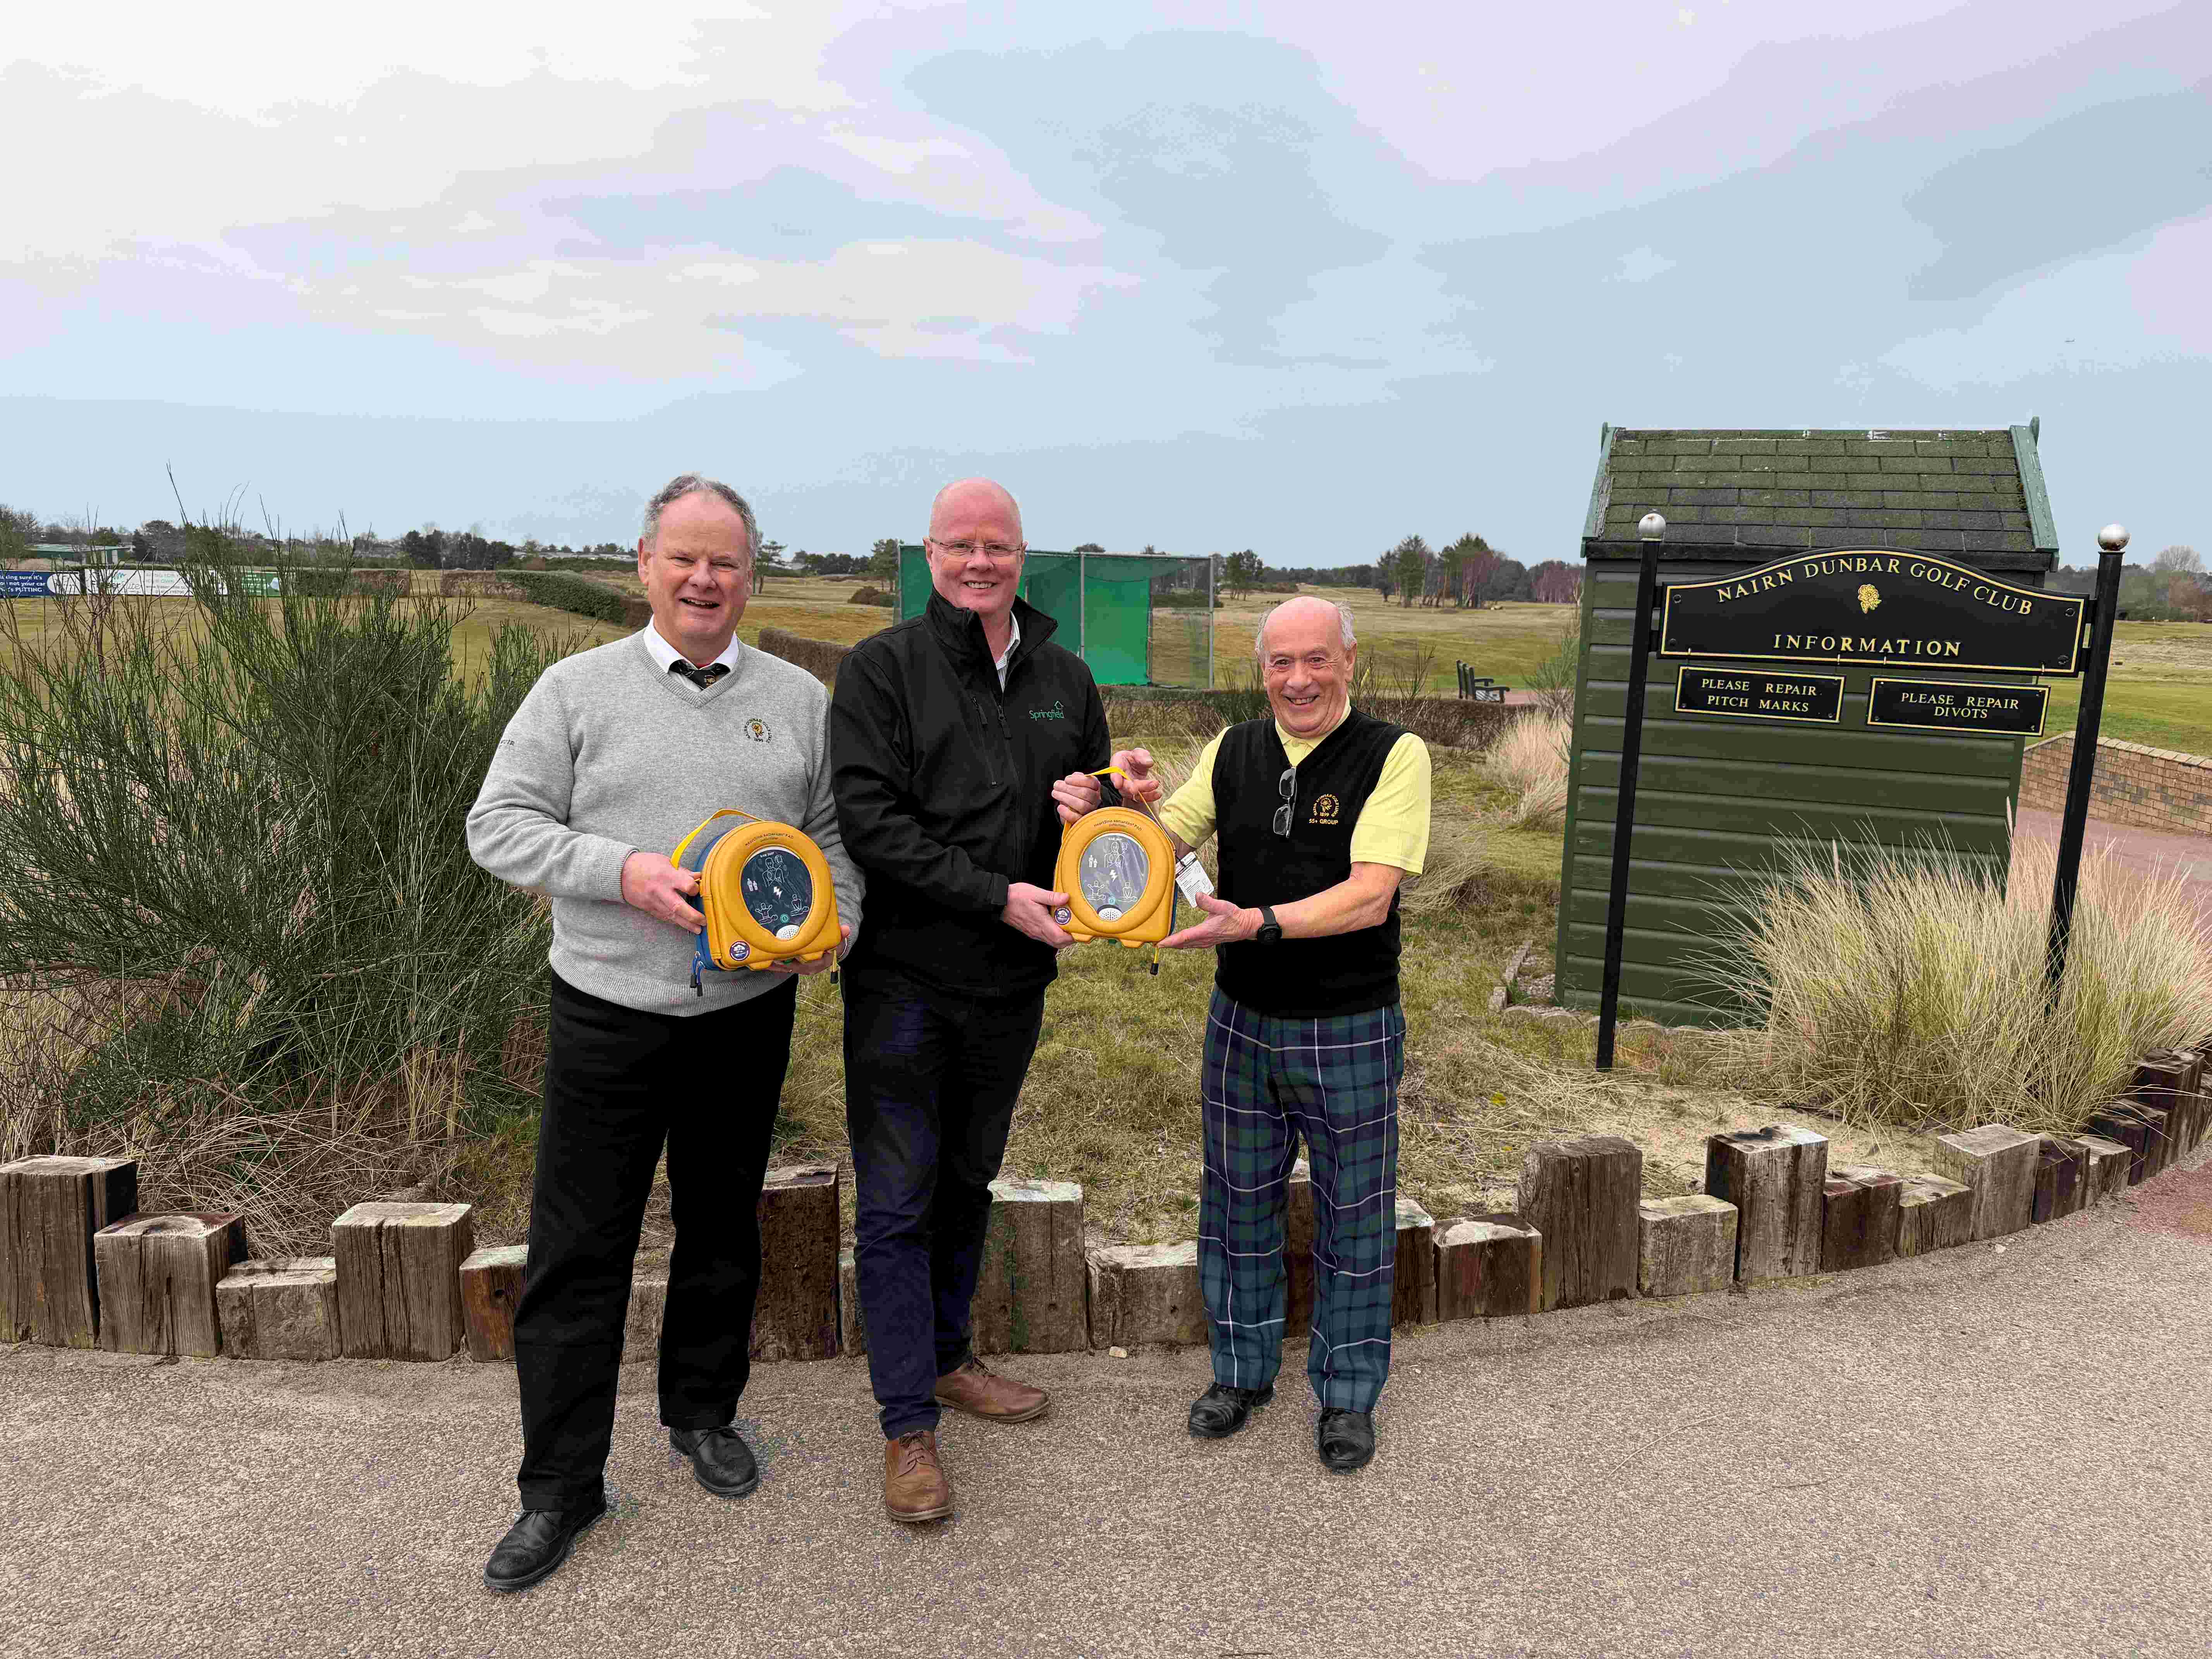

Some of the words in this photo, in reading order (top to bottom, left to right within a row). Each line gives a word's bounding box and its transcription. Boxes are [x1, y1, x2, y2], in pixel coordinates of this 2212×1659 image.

[1717, 568, 1794, 603] NAIRN
[1804, 557, 1900, 579] DUNBAR
[1910, 563, 1970, 591] GOLF
[1973, 586, 2032, 615] CLUB
[1774, 634, 1961, 656] INFORMATION
[1701, 678, 1750, 691] PLEASE
[1765, 683, 1817, 696] REPAIR
[1707, 695, 1749, 708] PITCH
[1759, 699, 1809, 712] MARKS
[1901, 692, 1954, 705] PLEASE
[1966, 696, 2019, 710] REPAIR
[1029, 709, 1065, 722] Springfield
[1934, 706, 1988, 719] DIVOTS
